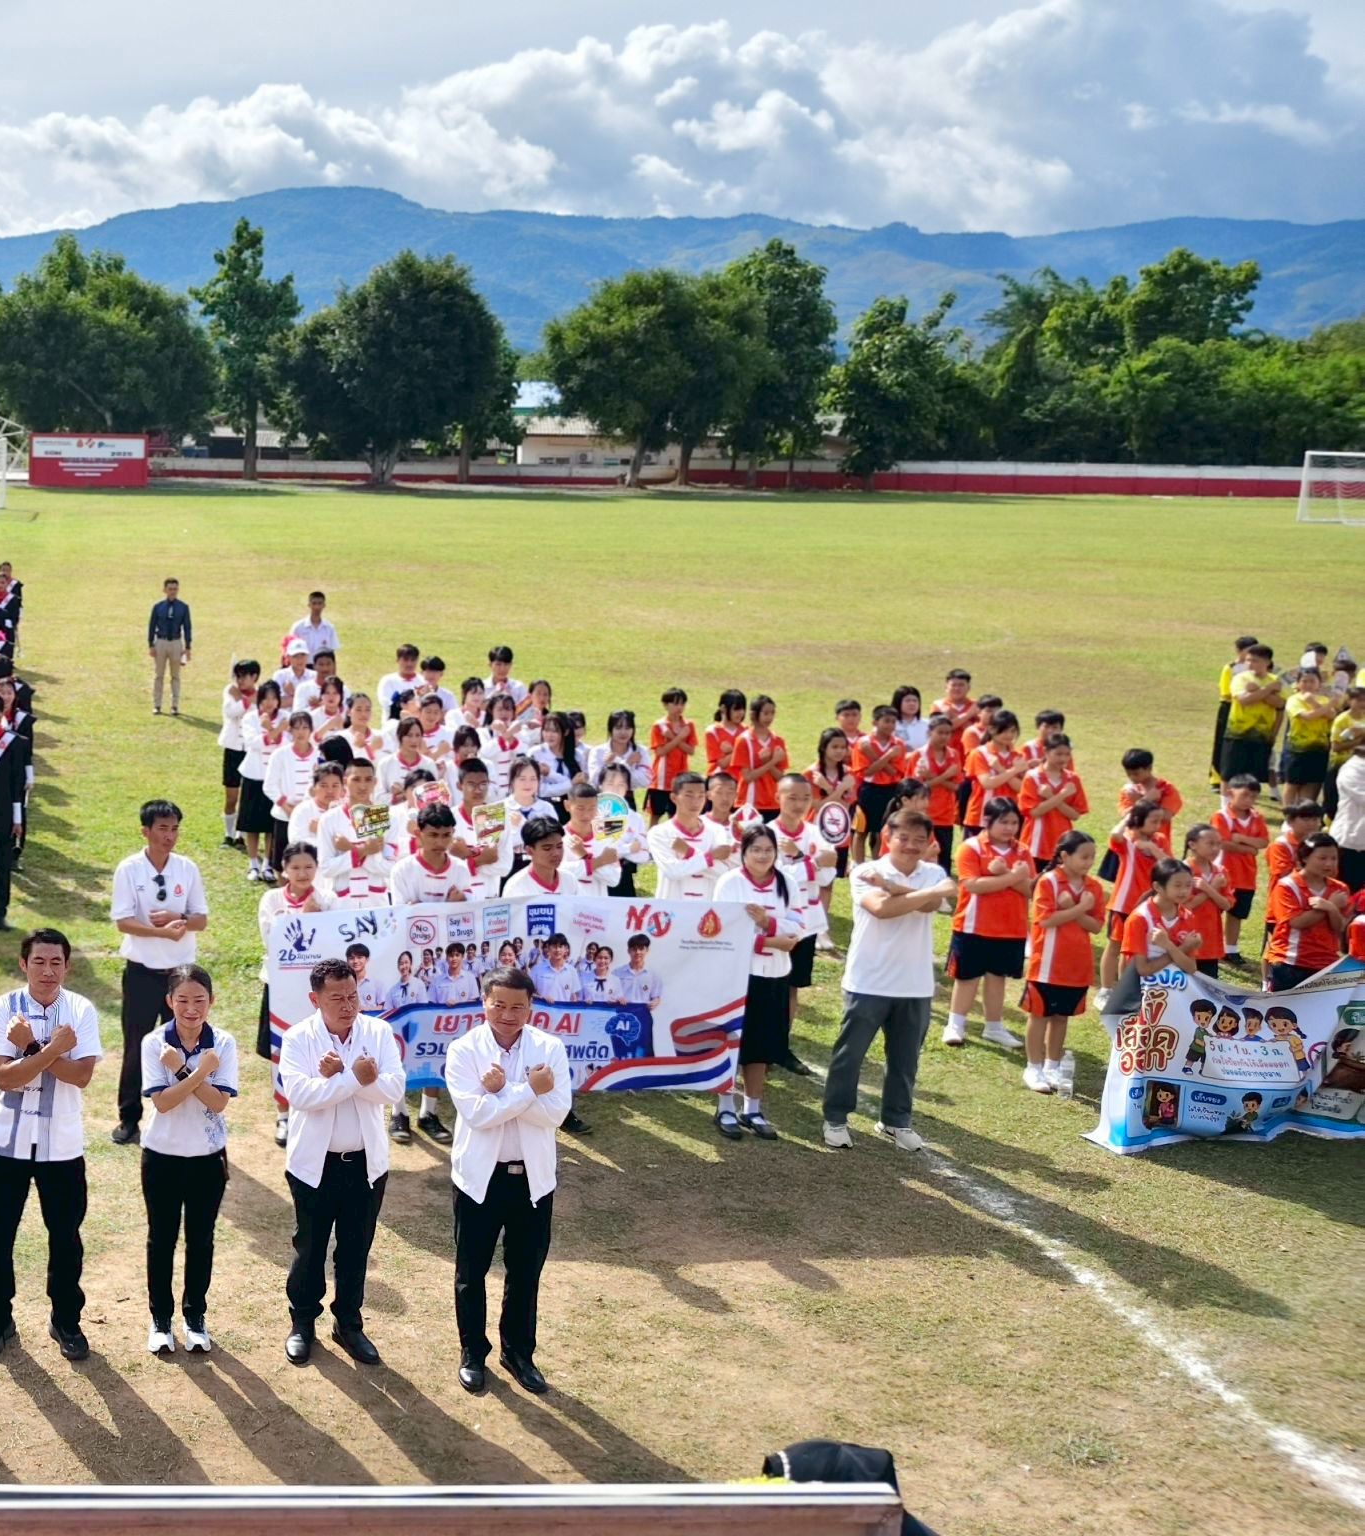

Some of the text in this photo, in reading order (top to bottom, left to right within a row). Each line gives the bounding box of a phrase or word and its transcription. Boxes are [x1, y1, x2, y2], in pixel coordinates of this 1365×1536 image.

[338, 911, 378, 942] SAY
[456, 929, 474, 937] Drugs
[278, 949, 297, 961] 26
[555, 1013, 581, 1034] AI
[616, 1020, 630, 1031] AI
